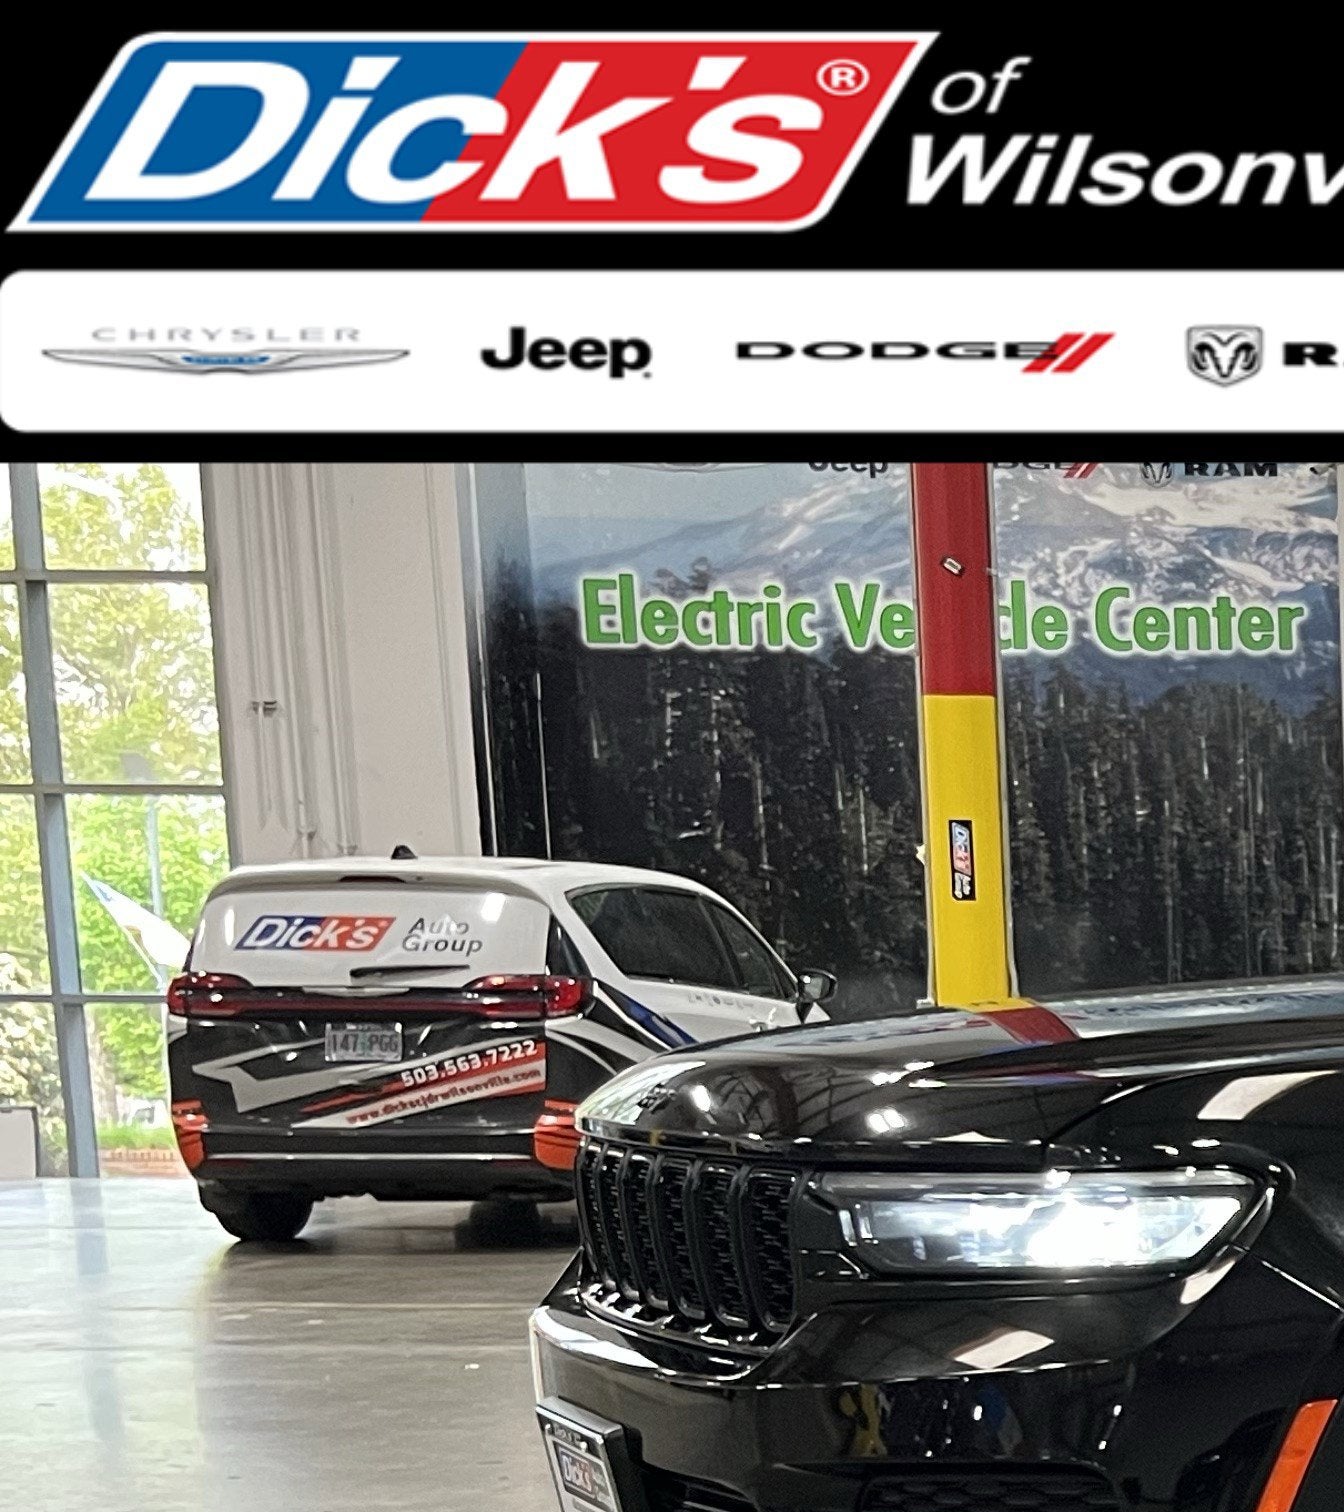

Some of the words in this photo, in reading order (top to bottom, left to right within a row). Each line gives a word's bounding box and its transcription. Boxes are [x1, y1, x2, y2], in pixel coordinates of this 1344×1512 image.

[581, 574, 817, 648] Electric
[834, 580, 1069, 651] Vele
[1095, 587, 1303, 651] Center
[242, 917, 380, 949] Dick's
[408, 917, 470, 936] Auto
[402, 933, 483, 957] Group
[400, 1039, 538, 1088] 503.563.7222
